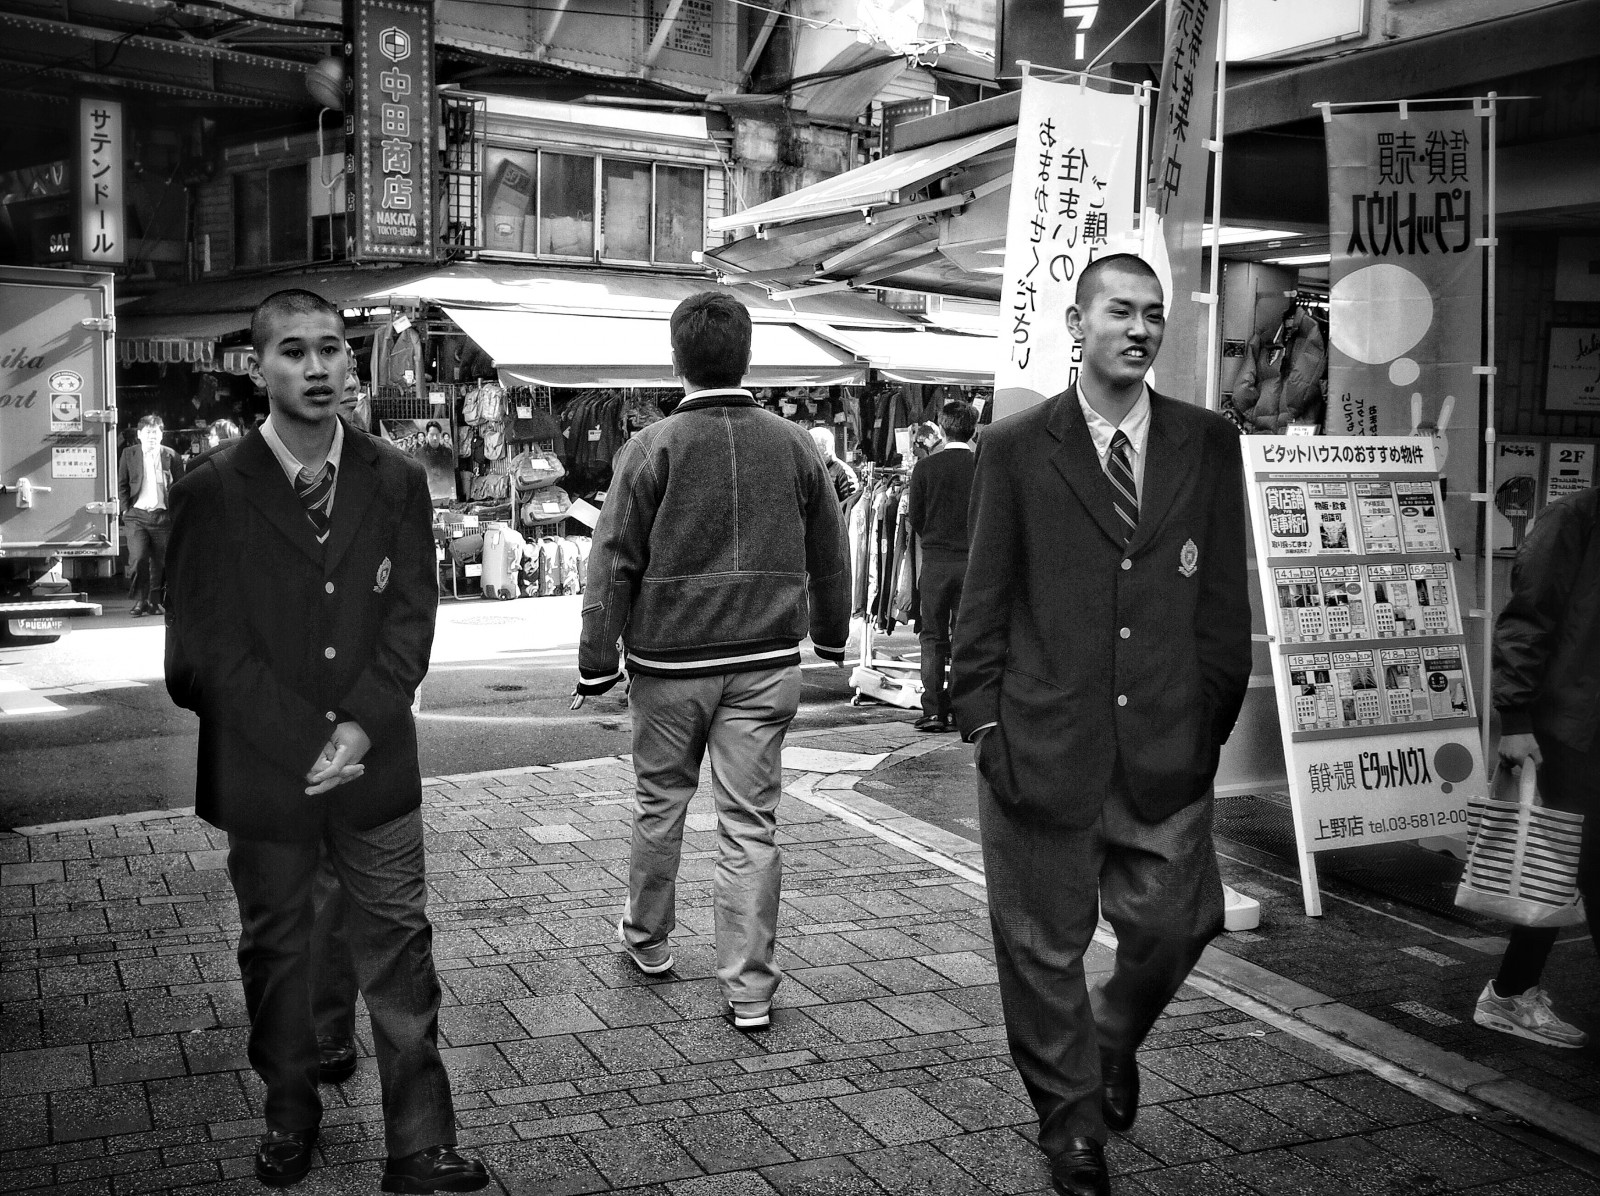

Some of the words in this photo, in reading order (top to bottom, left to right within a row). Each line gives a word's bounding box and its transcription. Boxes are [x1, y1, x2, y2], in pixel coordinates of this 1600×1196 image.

[380, 67, 413, 209] 中田商店
[90, 109, 114, 253] サテンドール
[376, 212, 417, 226] NAKATA
[1262, 443, 1424, 466] ピタットハウスのおすすめ物件
[1559, 450, 1585, 463] 2F
[1266, 488, 1305, 510] 貸店舗
[1269, 513, 1308, 534] 貸事務所
[1308, 761, 1357, 794] 賃貸・売買
[1358, 747, 1433, 790] ピタットハウス
[1314, 815, 1364, 841] 上野店
[1368, 809, 1468, 834] tel.03-5812-00
